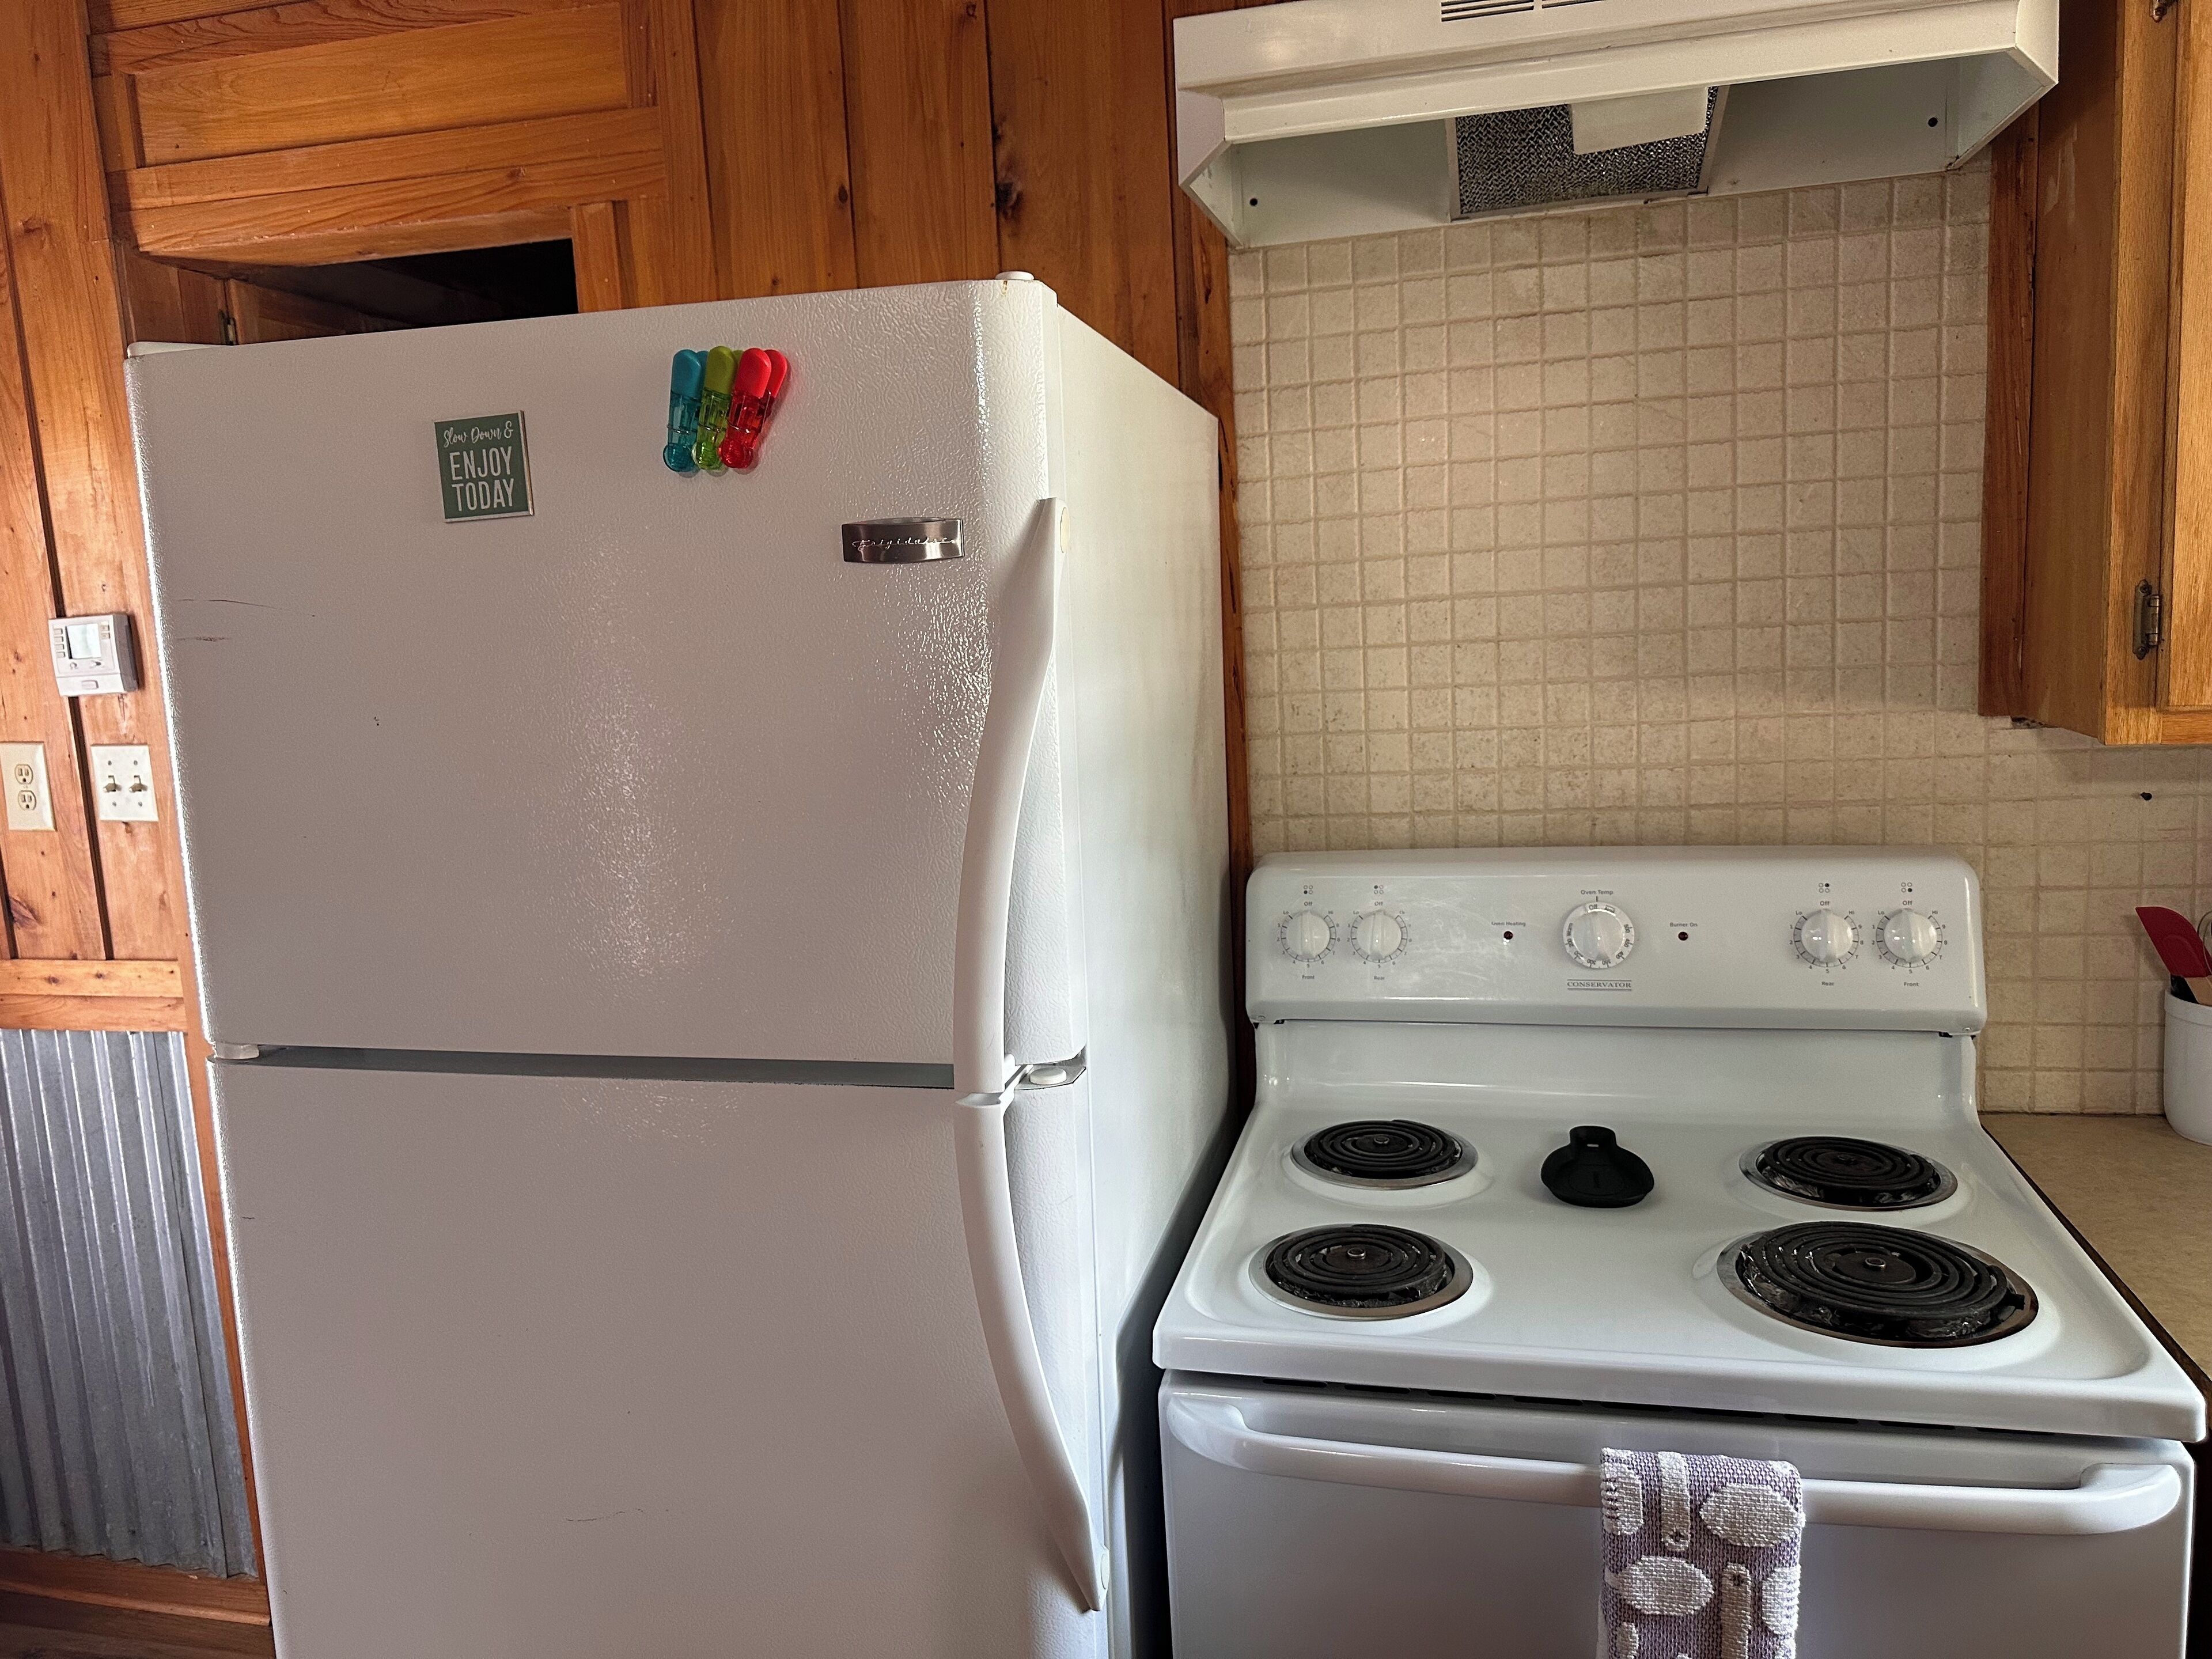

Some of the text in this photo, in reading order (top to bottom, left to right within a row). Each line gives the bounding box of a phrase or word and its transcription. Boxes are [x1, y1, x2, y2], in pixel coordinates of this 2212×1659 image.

[444, 421, 514, 448] Slow Down &
[449, 446, 512, 480] ENJOY
[452, 478, 514, 512] TODAY
